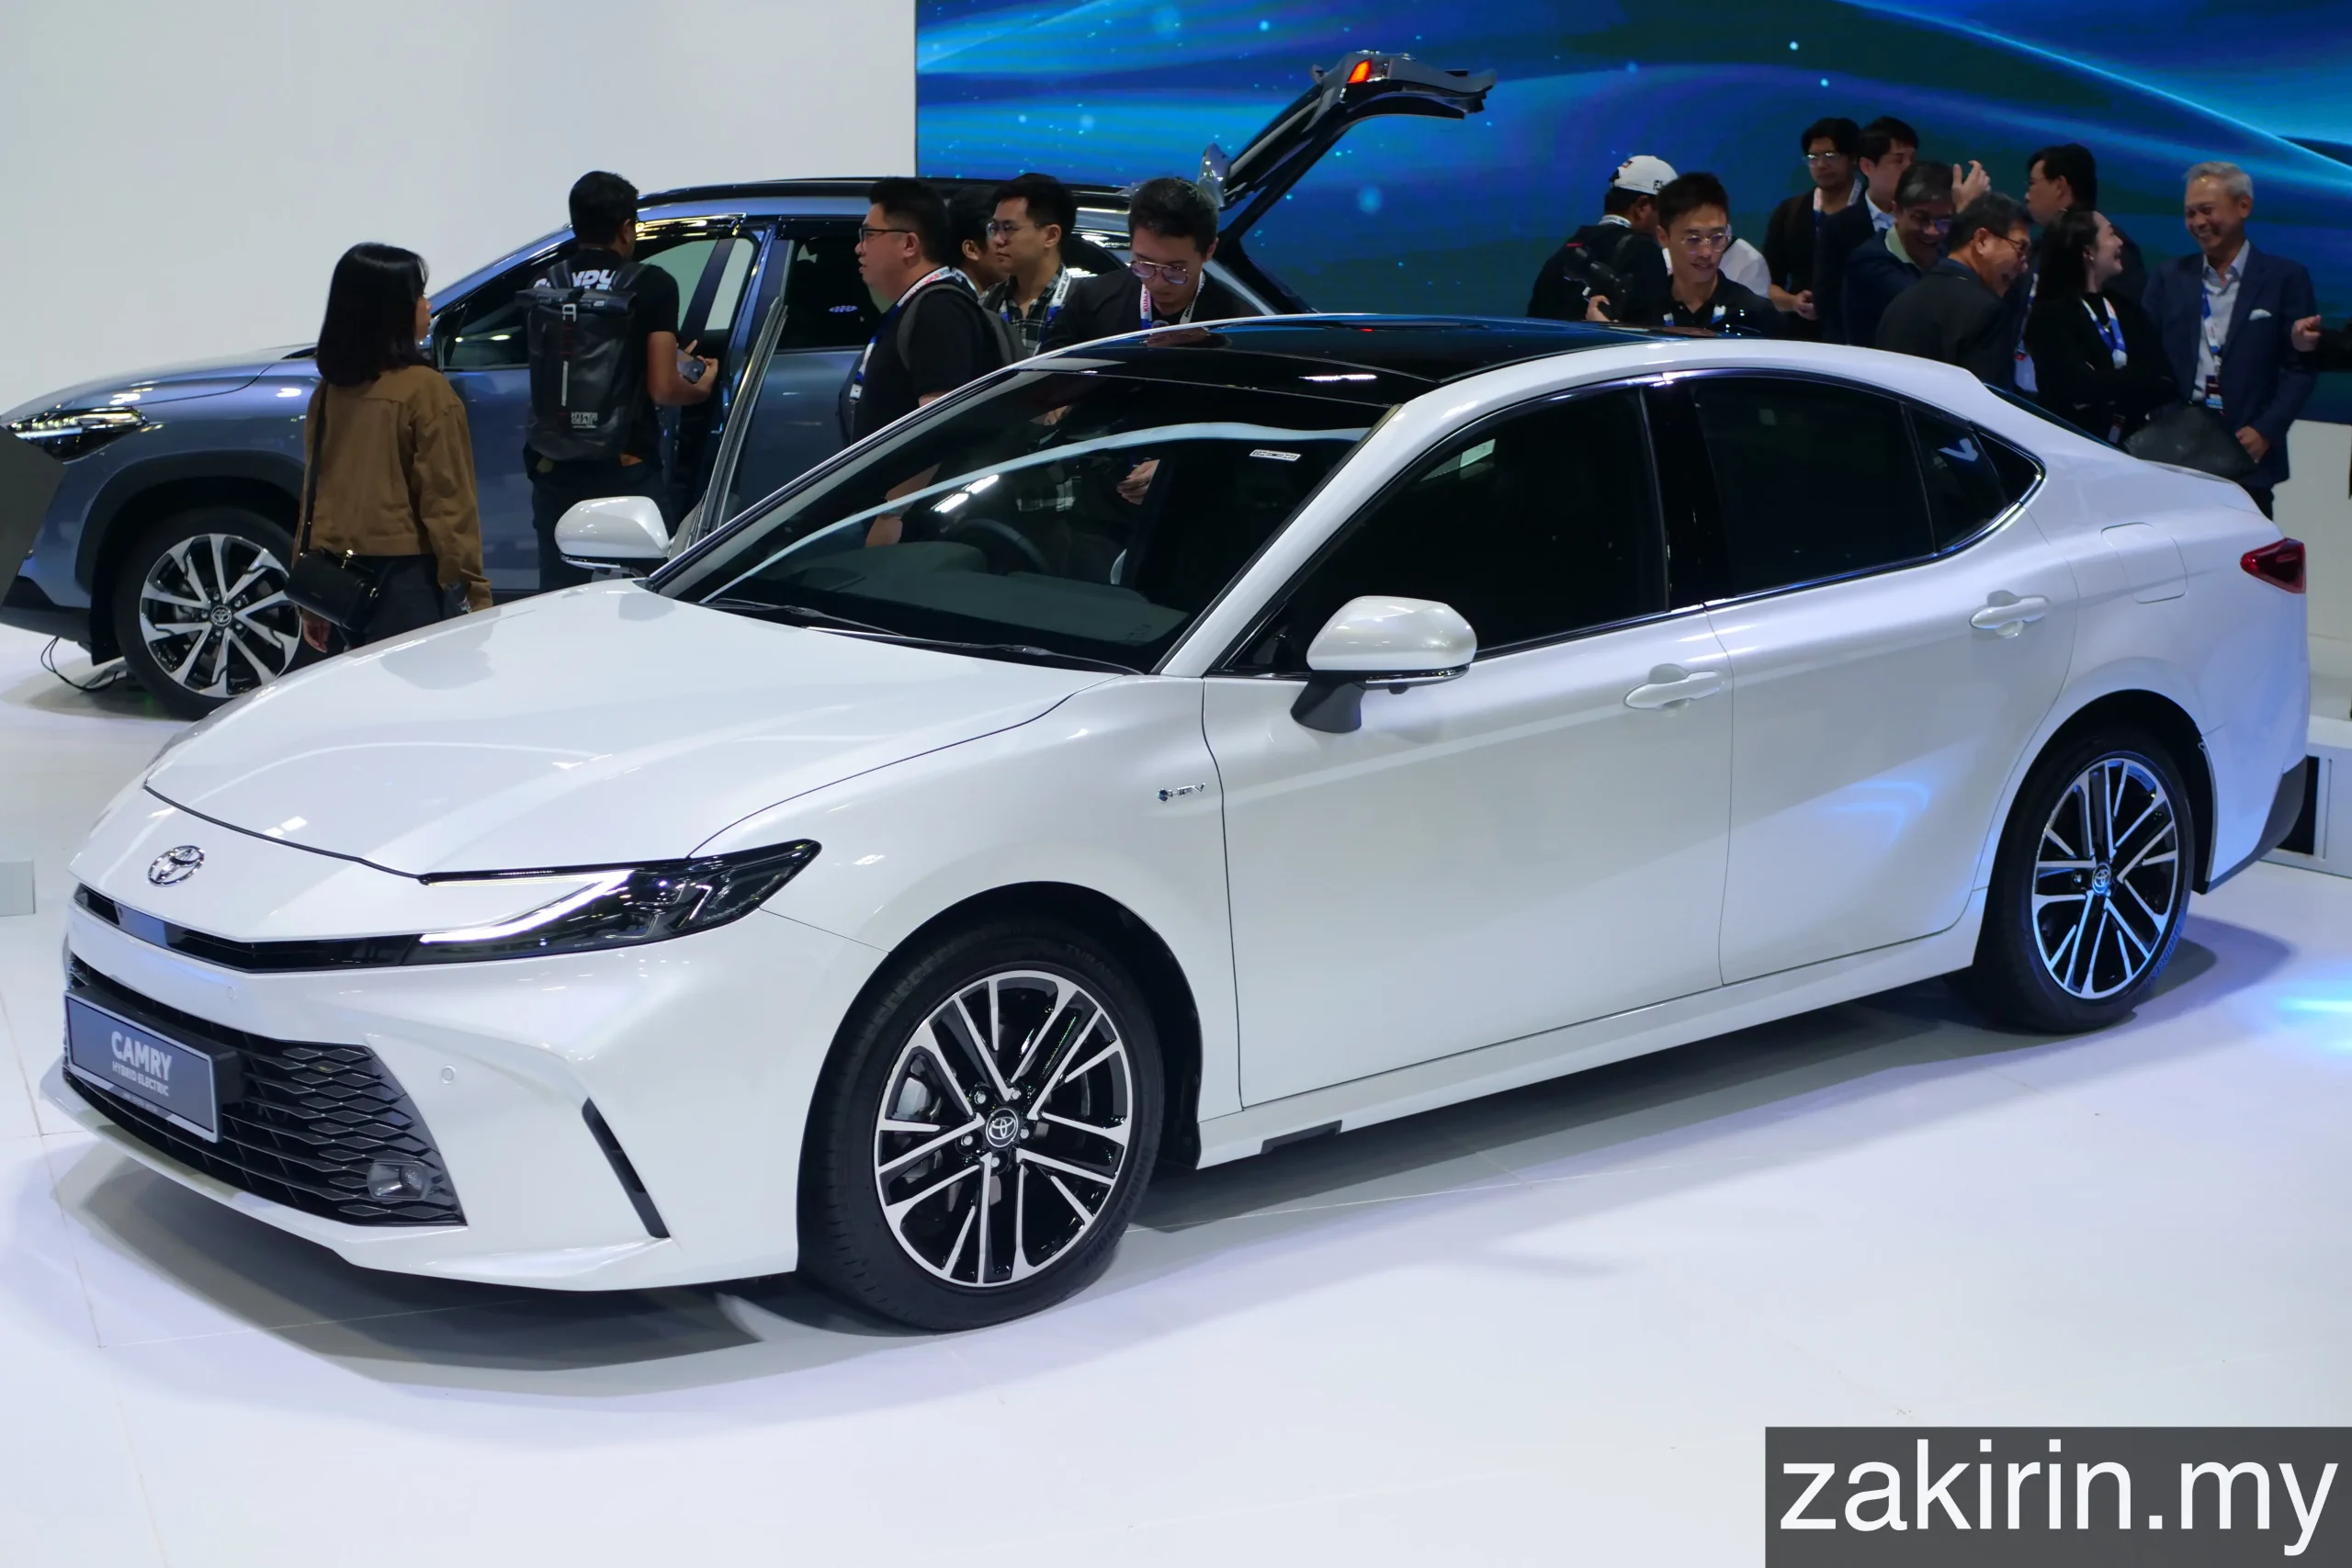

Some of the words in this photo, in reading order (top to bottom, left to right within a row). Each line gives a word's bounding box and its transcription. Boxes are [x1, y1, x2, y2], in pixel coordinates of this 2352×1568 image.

[111, 1031, 173, 1082] CAMRY
[112, 1060, 137, 1082] HYBRID
[137, 1072, 170, 1098] ELECTRIC
